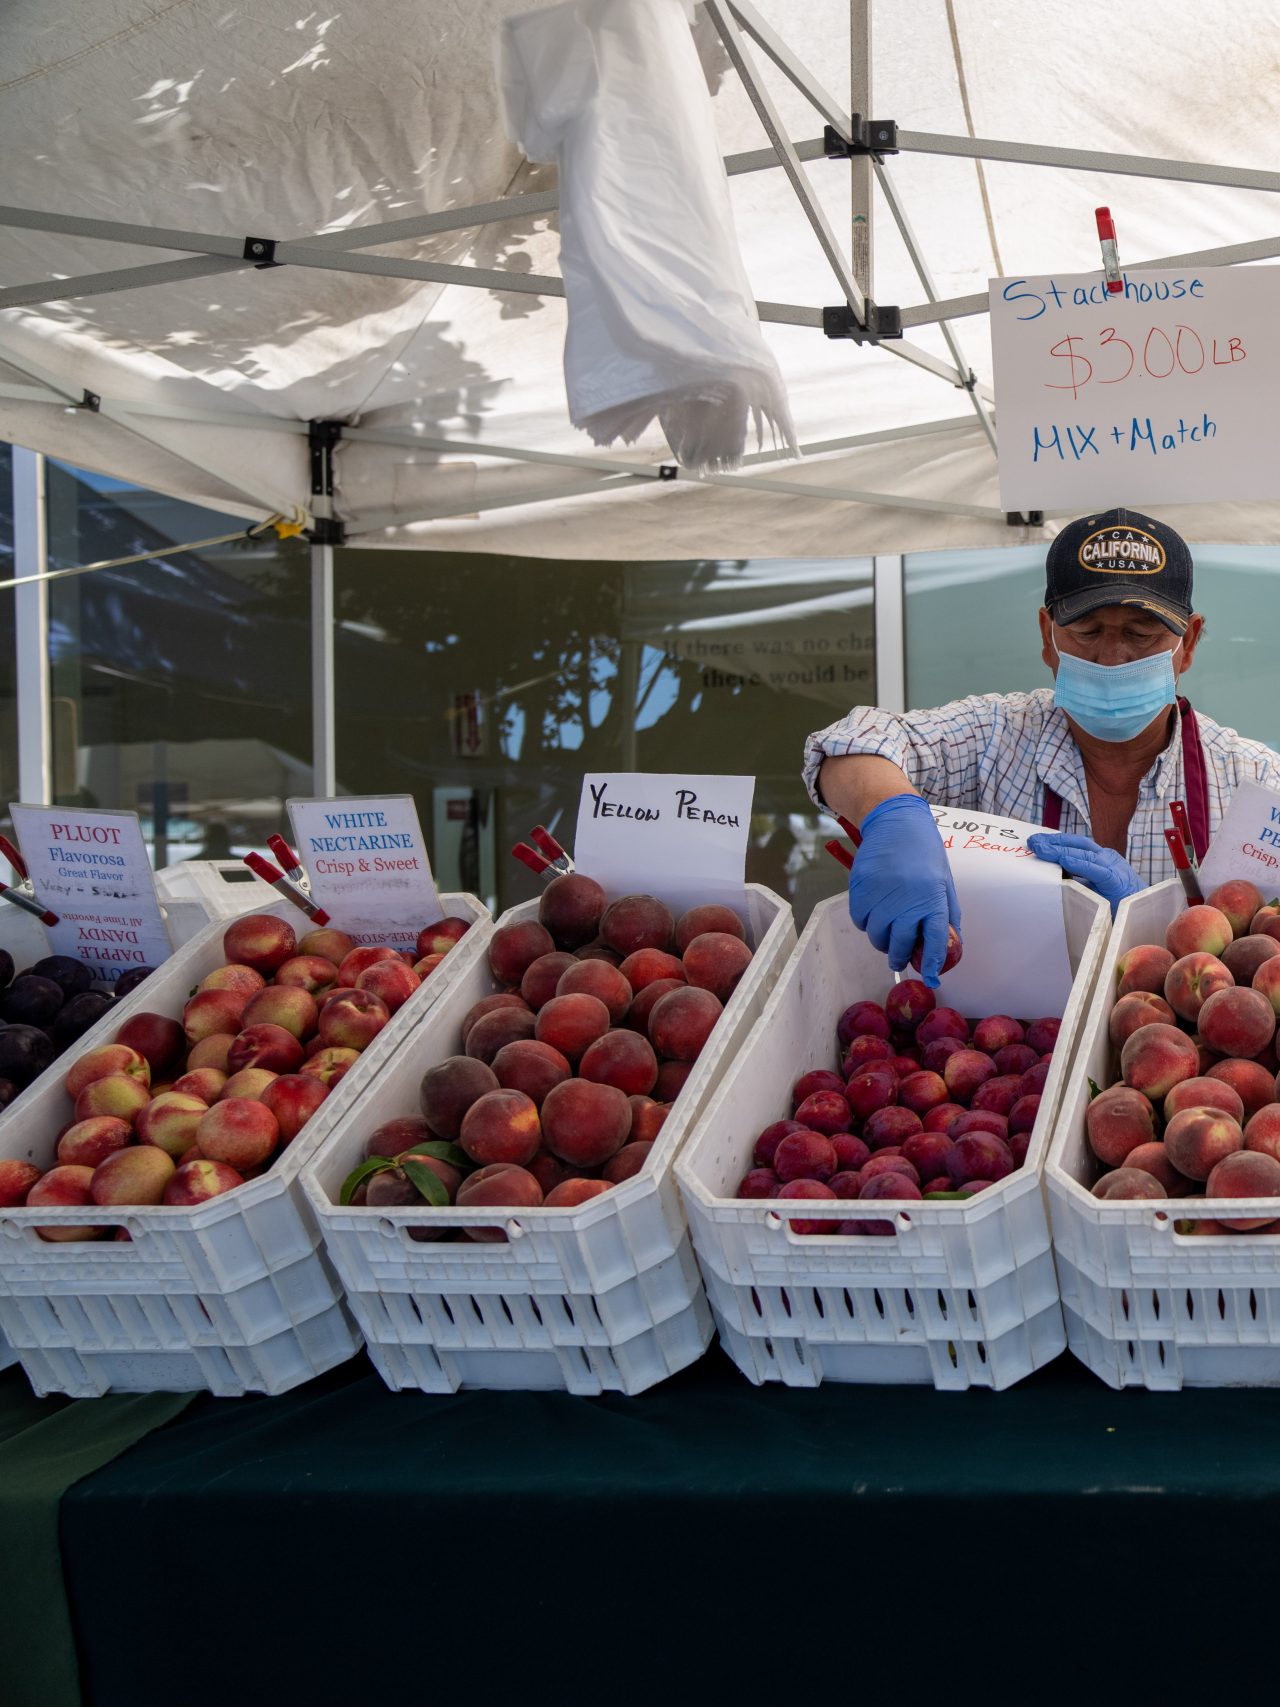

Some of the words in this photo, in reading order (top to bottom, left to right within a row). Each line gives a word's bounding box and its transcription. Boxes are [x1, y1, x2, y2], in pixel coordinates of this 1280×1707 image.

[1212, 337, 1247, 365] LB
[1082, 540, 1161, 565] CALIFORNIA
[1108, 560, 1136, 569] USA
[802, 635, 830, 651] no
[768, 663, 835, 687] would
[843, 664, 869, 683] be
[324, 812, 388, 829] WHITE
[50, 823, 122, 845] PLUOT
[309, 833, 414, 853] NECTARINE
[48, 847, 127, 867] Flavorosa
[1242, 843, 1280, 869] Crisp,
[58, 867, 88, 878] Great
[90, 869, 124, 881] Flavor
[315, 858, 355, 876] Crisp
[358, 858, 372, 873] &
[374, 856, 420, 872] Sweet
[62, 912, 101, 924] Favorite
[102, 915, 128, 926] Time
[129, 917, 143, 927] All
[78, 927, 140, 944] DANDY
[77, 946, 146, 963] DAPPLE
